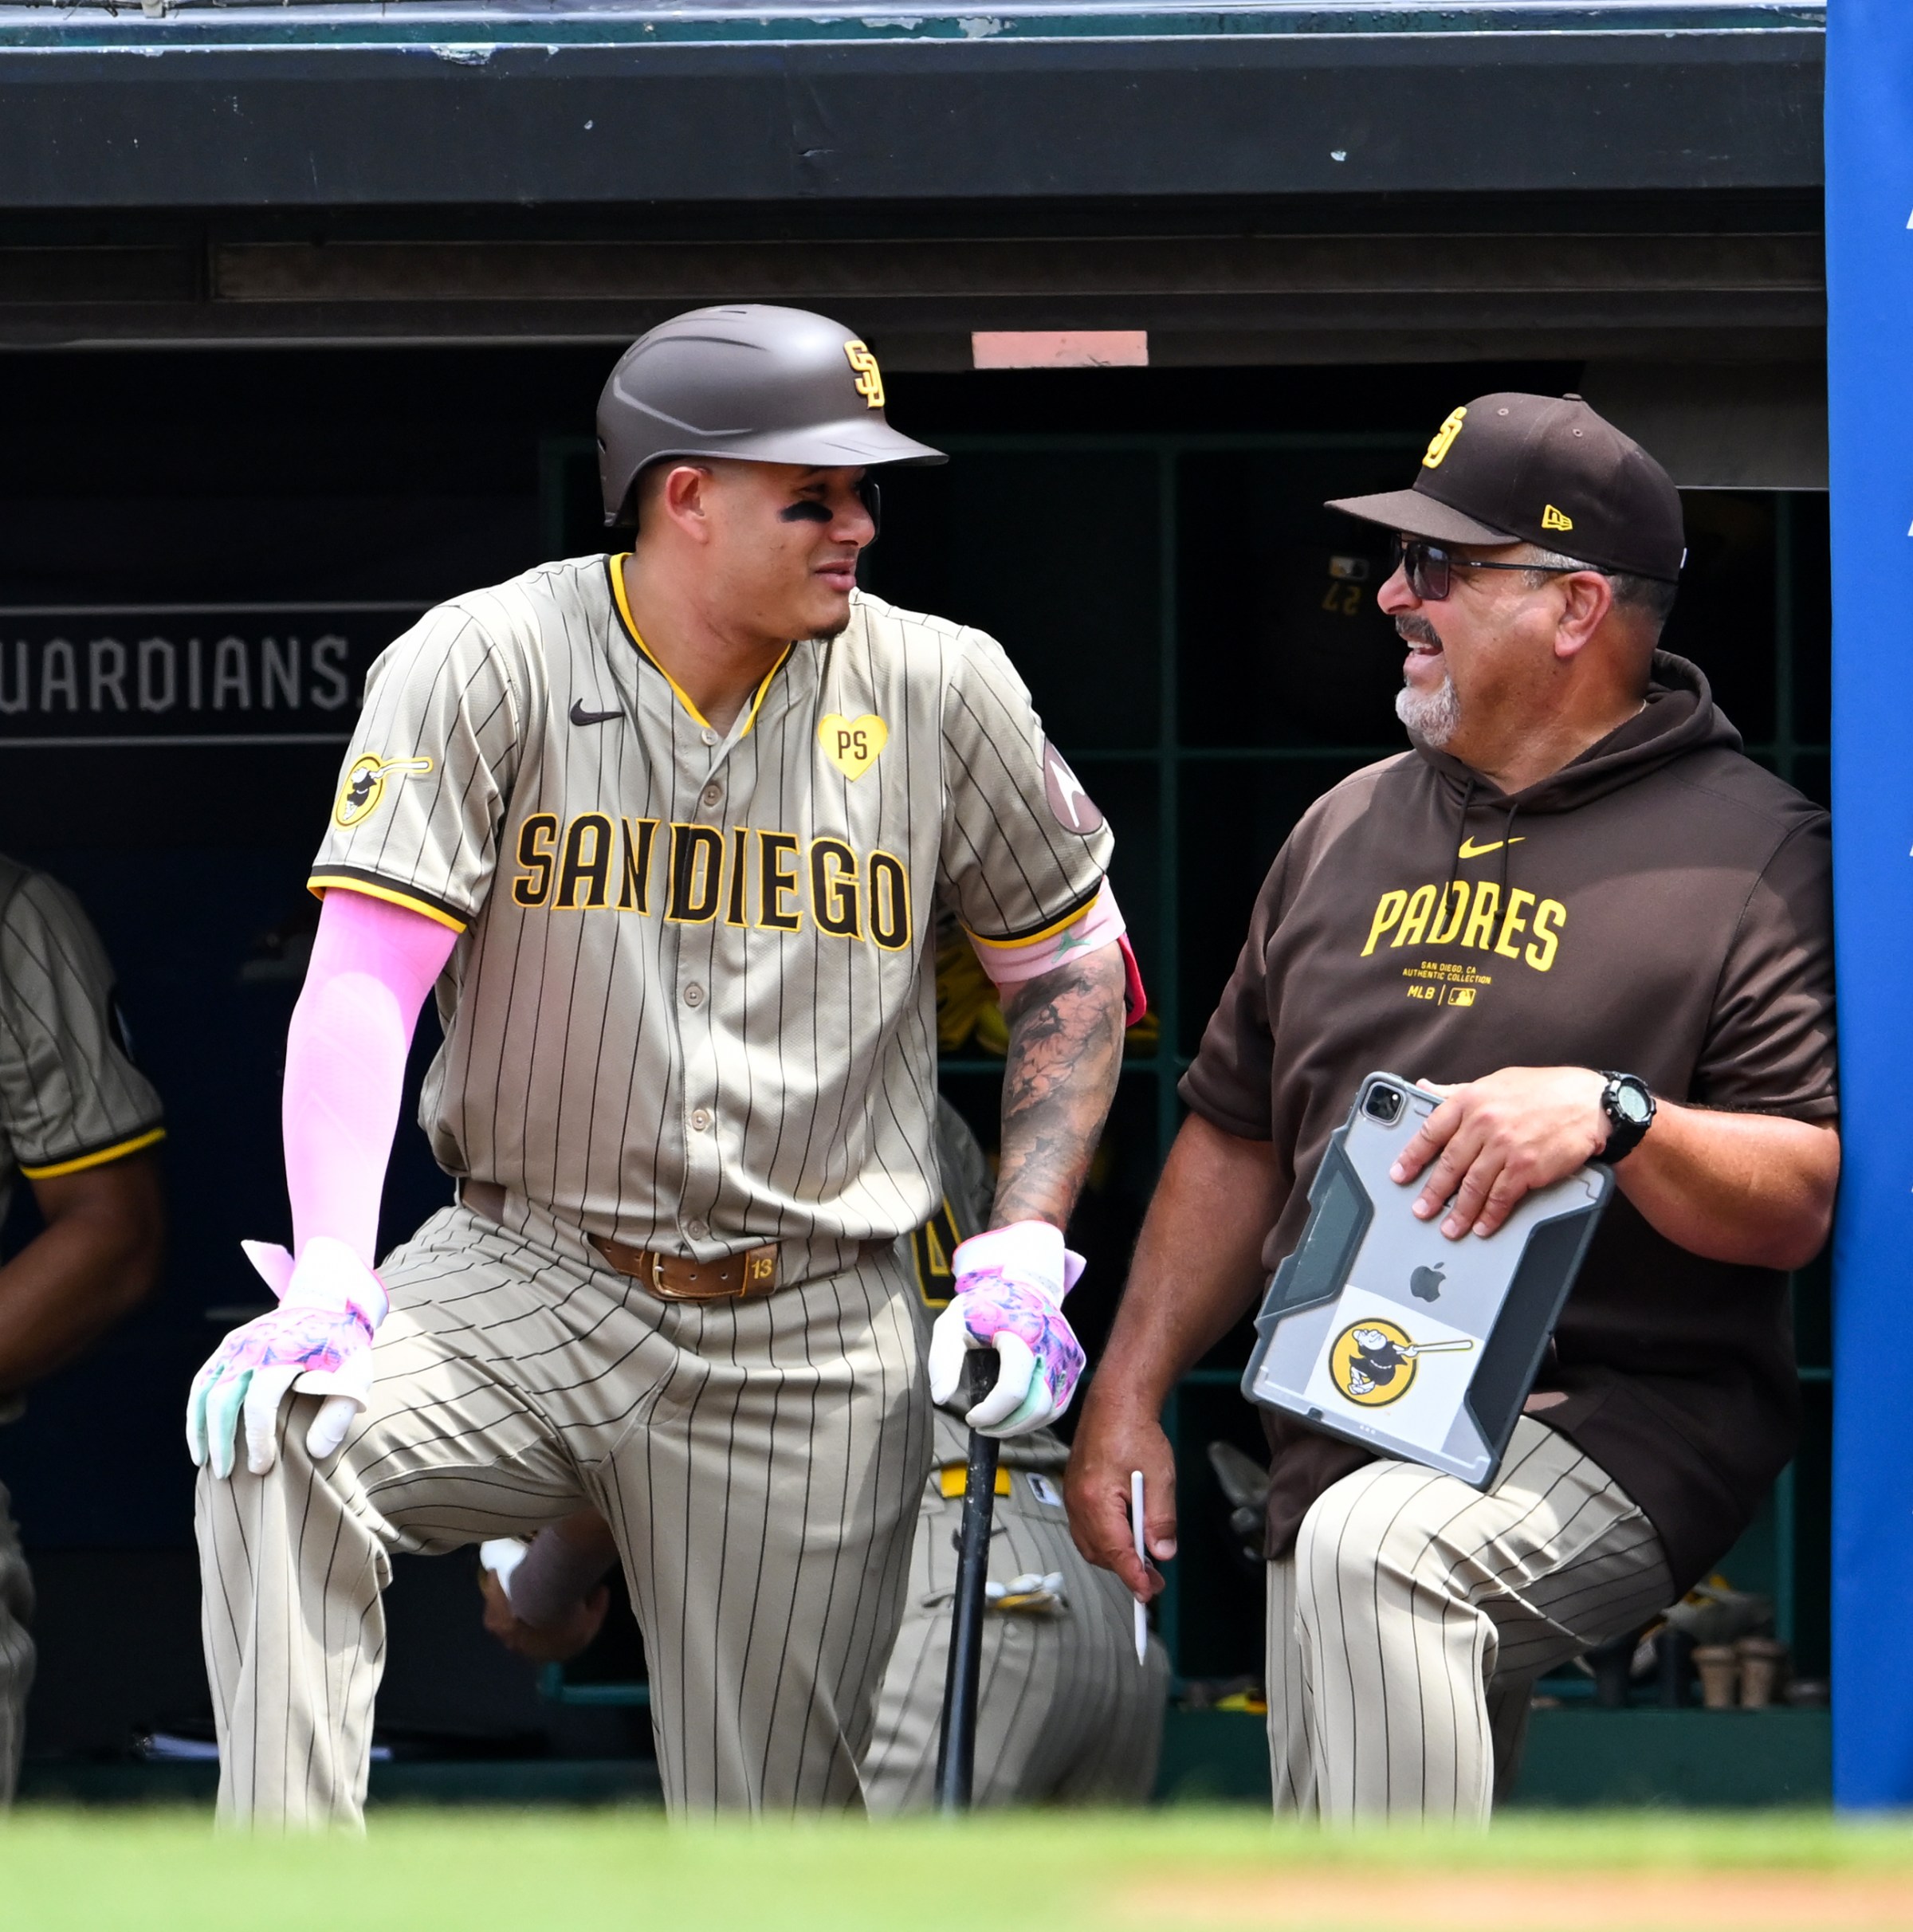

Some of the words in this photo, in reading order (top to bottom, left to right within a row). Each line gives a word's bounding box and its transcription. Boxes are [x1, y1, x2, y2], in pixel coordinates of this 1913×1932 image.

[836, 729, 869, 760] PS
[512, 811, 661, 917] SAN
[664, 823, 912, 952] DIEGO
[1360, 880, 1567, 972] PADRES
[1403, 968, 1445, 980] AUTHENTIC
[1447, 972, 1492, 984] COLLECTION
[1420, 960, 1438, 970] SAN
[1467, 966, 1476, 975] CA
[1407, 985, 1436, 1000] MLB
[751, 1259, 772, 1279] 13
